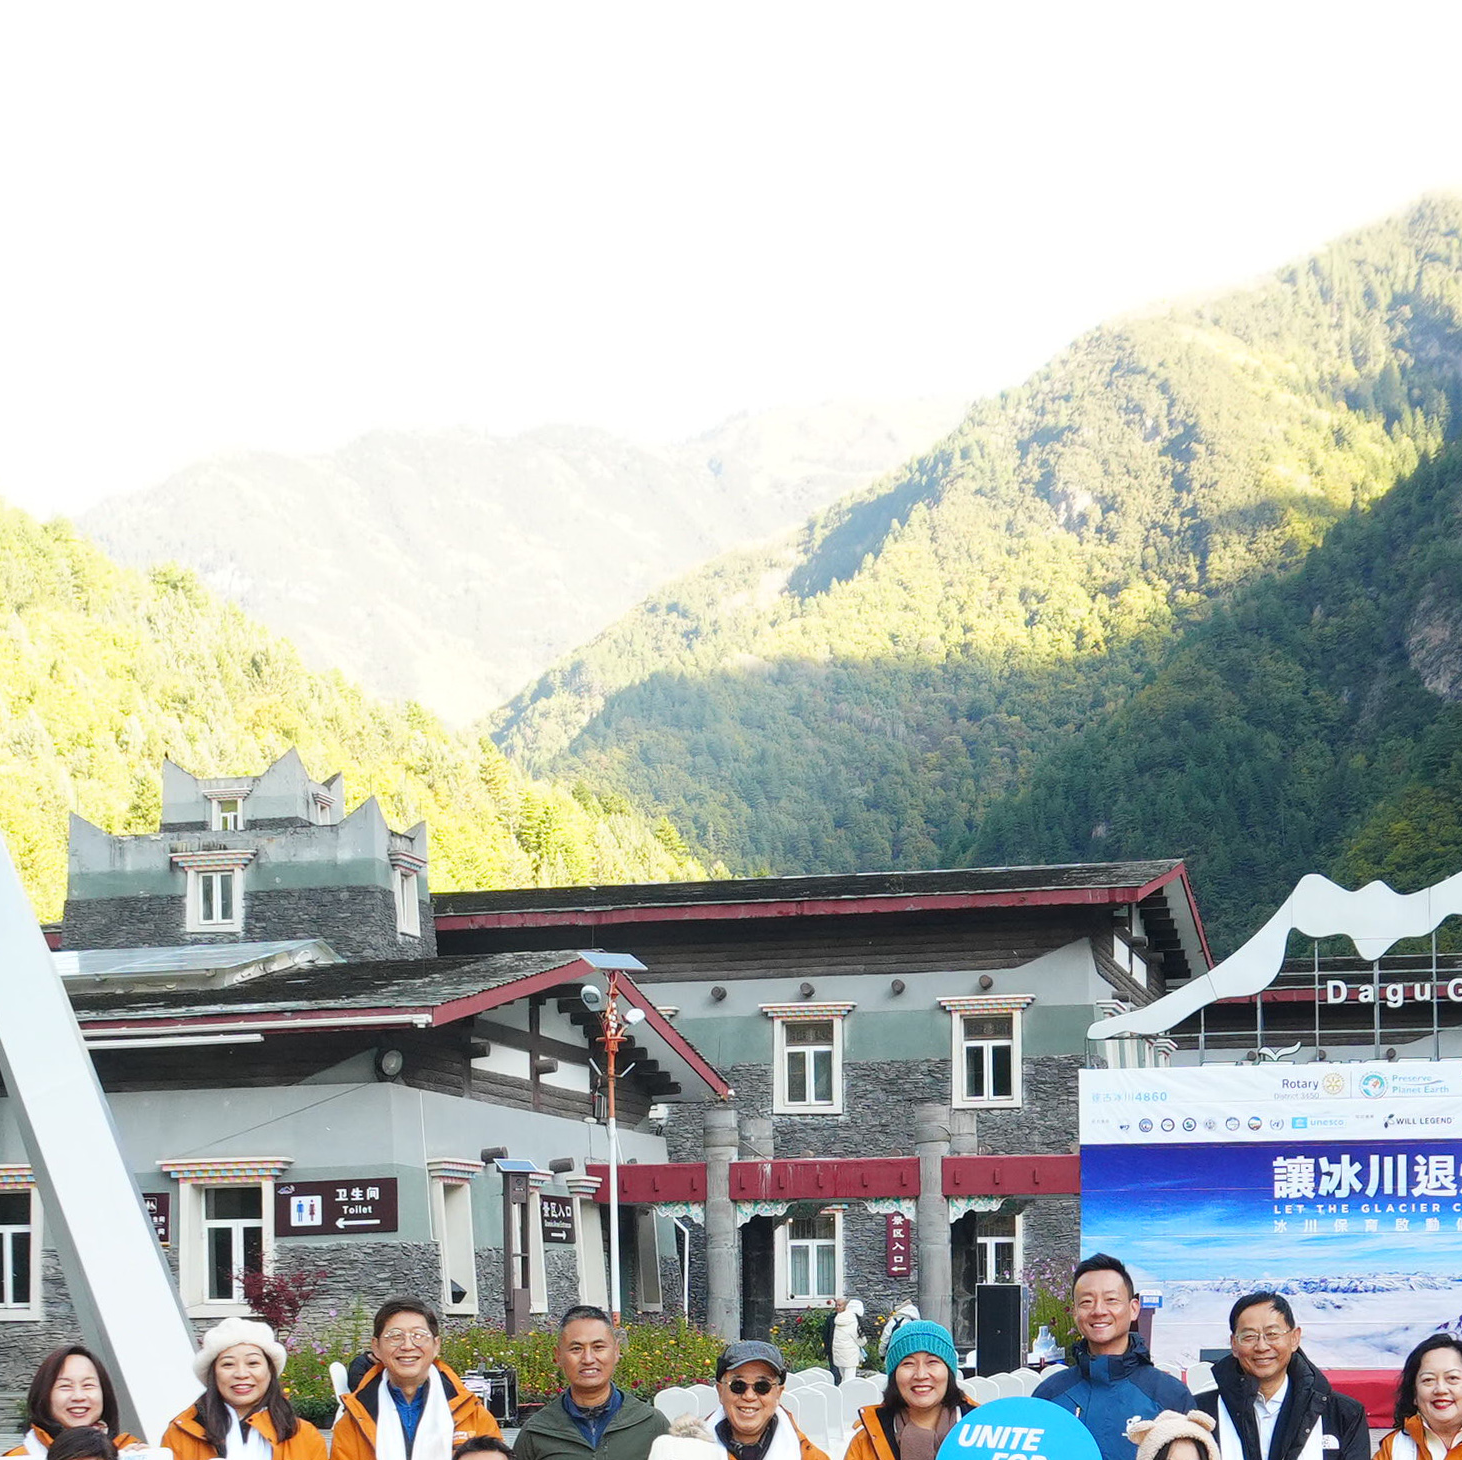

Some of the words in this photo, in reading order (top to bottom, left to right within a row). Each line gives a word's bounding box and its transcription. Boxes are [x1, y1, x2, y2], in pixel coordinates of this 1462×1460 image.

[1326, 979, 1432, 1008] Dagu
[1392, 1074, 1432, 1082] Preserve
[1282, 1079, 1319, 1091] Rotary
[1392, 1086, 1421, 1094] Planet
[1424, 1085, 1449, 1093] Earth
[1419, 1116, 1452, 1125] LEGEND
[335, 1186, 380, 1201] 卫生间
[342, 1205, 373, 1215] Toilet
[1274, 1204, 1304, 1214] LET
[1316, 1203, 1349, 1214] THE
[1361, 1202, 1441, 1213] GLACIER
[891, 1214, 905, 1264] 景区入口
[958, 1424, 1045, 1451] UNITE
